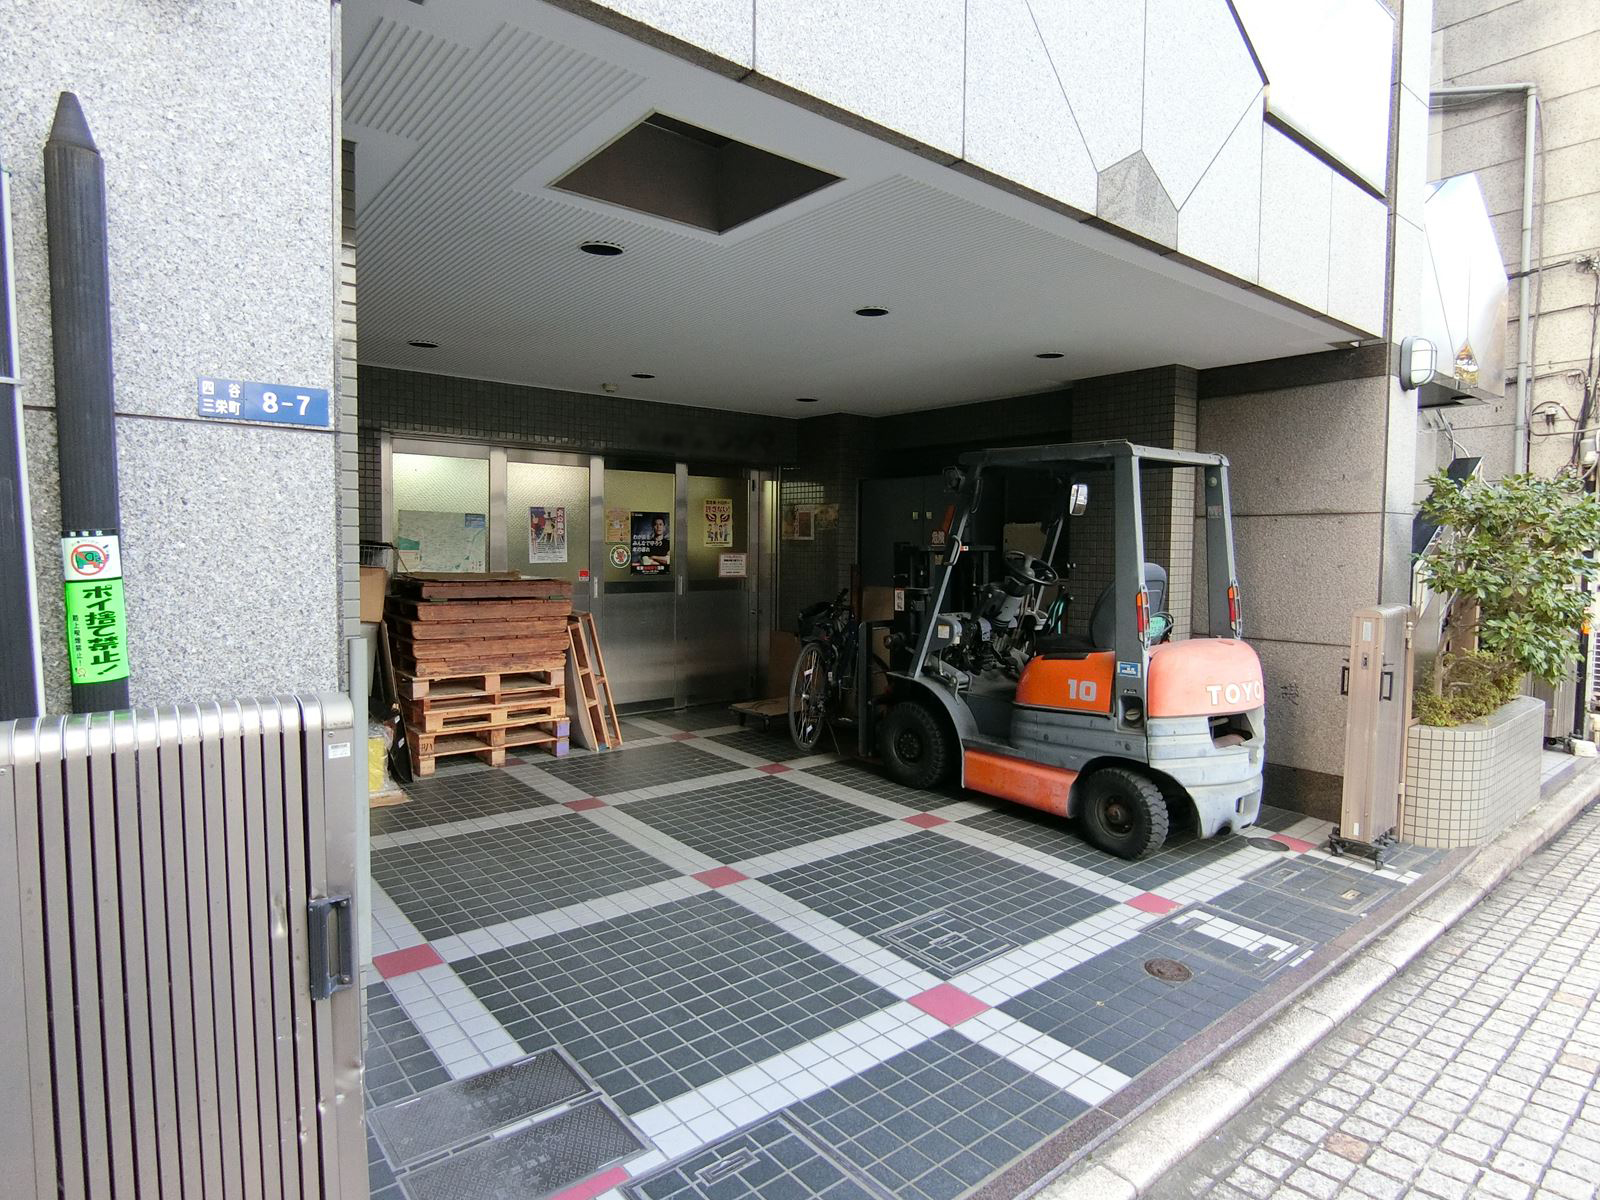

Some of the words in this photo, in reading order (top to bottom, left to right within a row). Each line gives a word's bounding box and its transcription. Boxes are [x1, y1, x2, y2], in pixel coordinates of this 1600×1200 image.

[202, 380, 240, 399] 四谷
[202, 398, 241, 416] 三栄町
[262, 392, 311, 416] 8-7
[1067, 679, 1098, 702] 10
